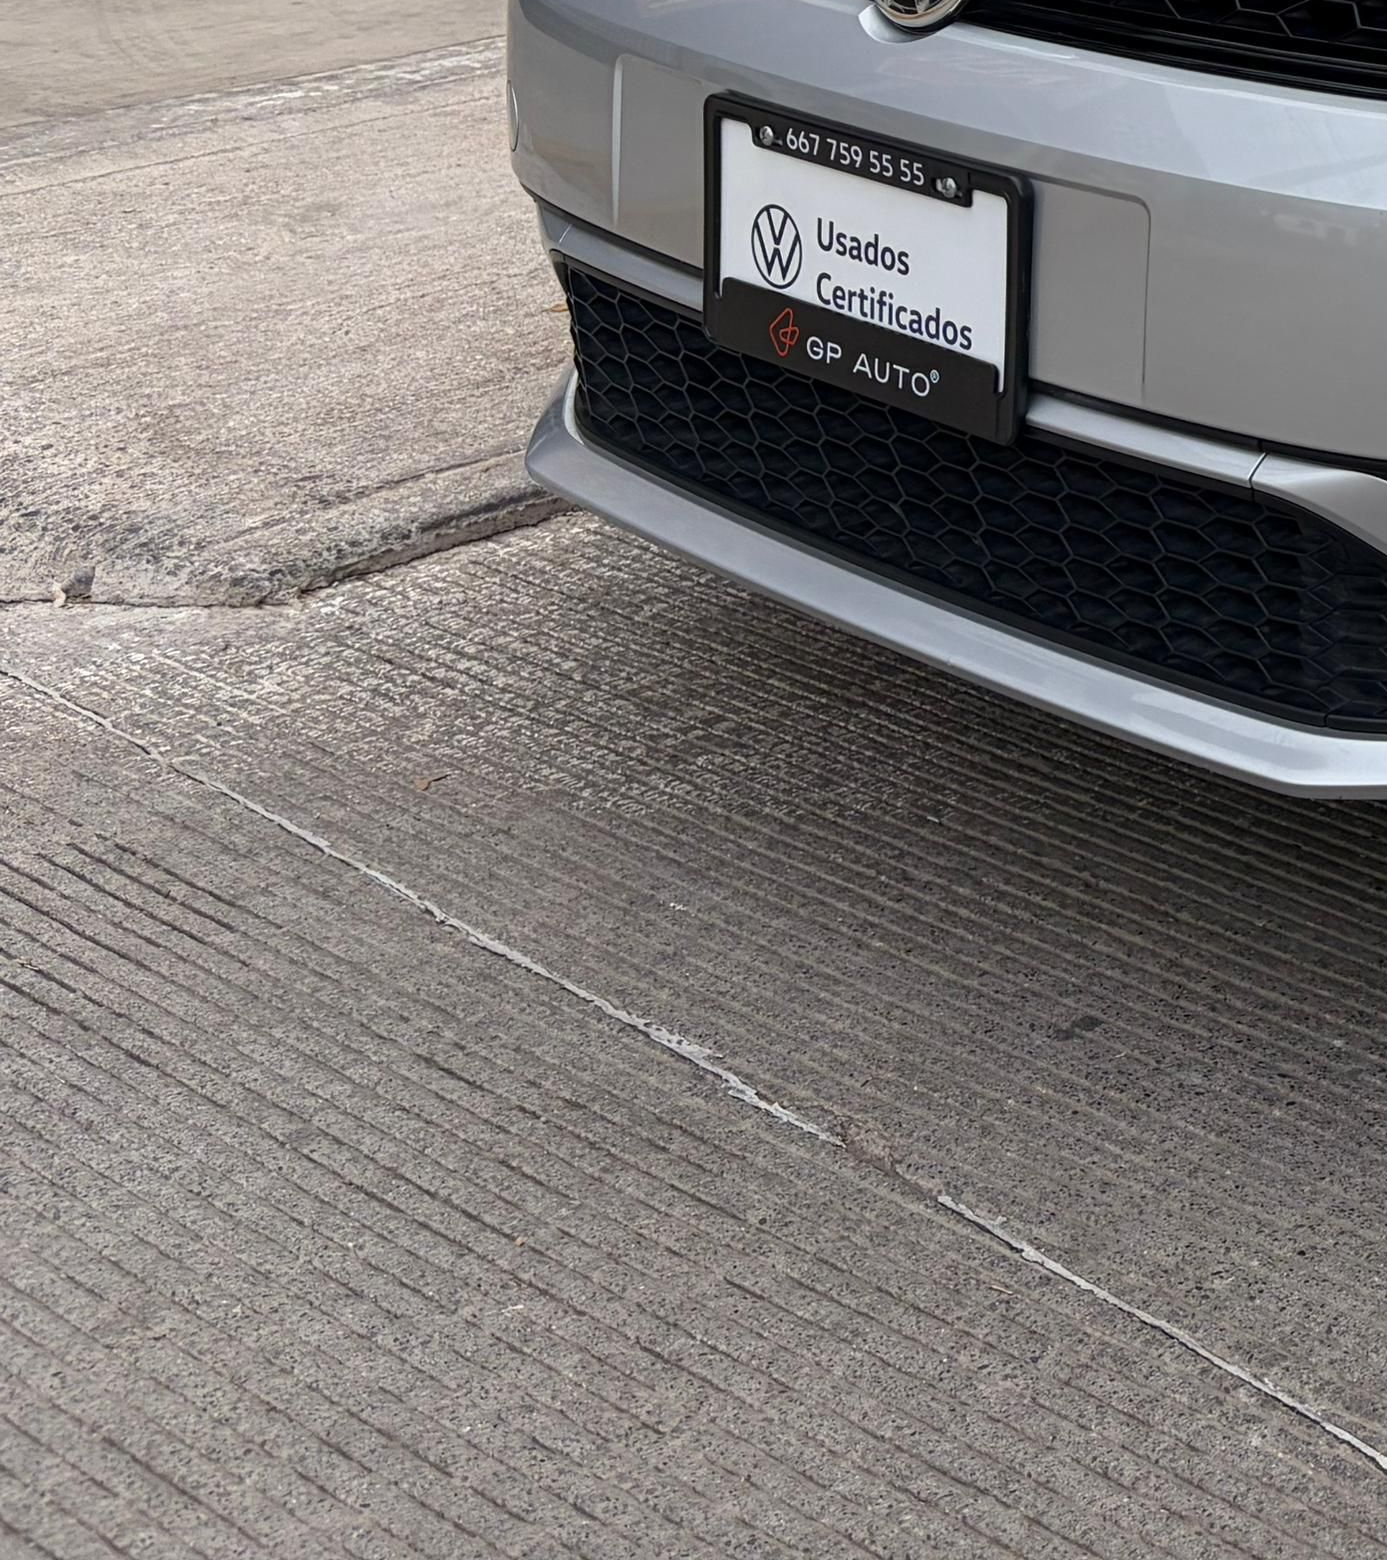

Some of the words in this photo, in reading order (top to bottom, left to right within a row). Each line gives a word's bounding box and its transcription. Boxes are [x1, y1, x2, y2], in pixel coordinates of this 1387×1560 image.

[786, 127, 820, 155] 667
[826, 138, 862, 168] 759
[869, 150, 894, 177] 55
[899, 158, 925, 186] 55
[816, 216, 911, 276] Usados
[815, 272, 974, 352] Certificados
[805, 335, 842, 364] GP
